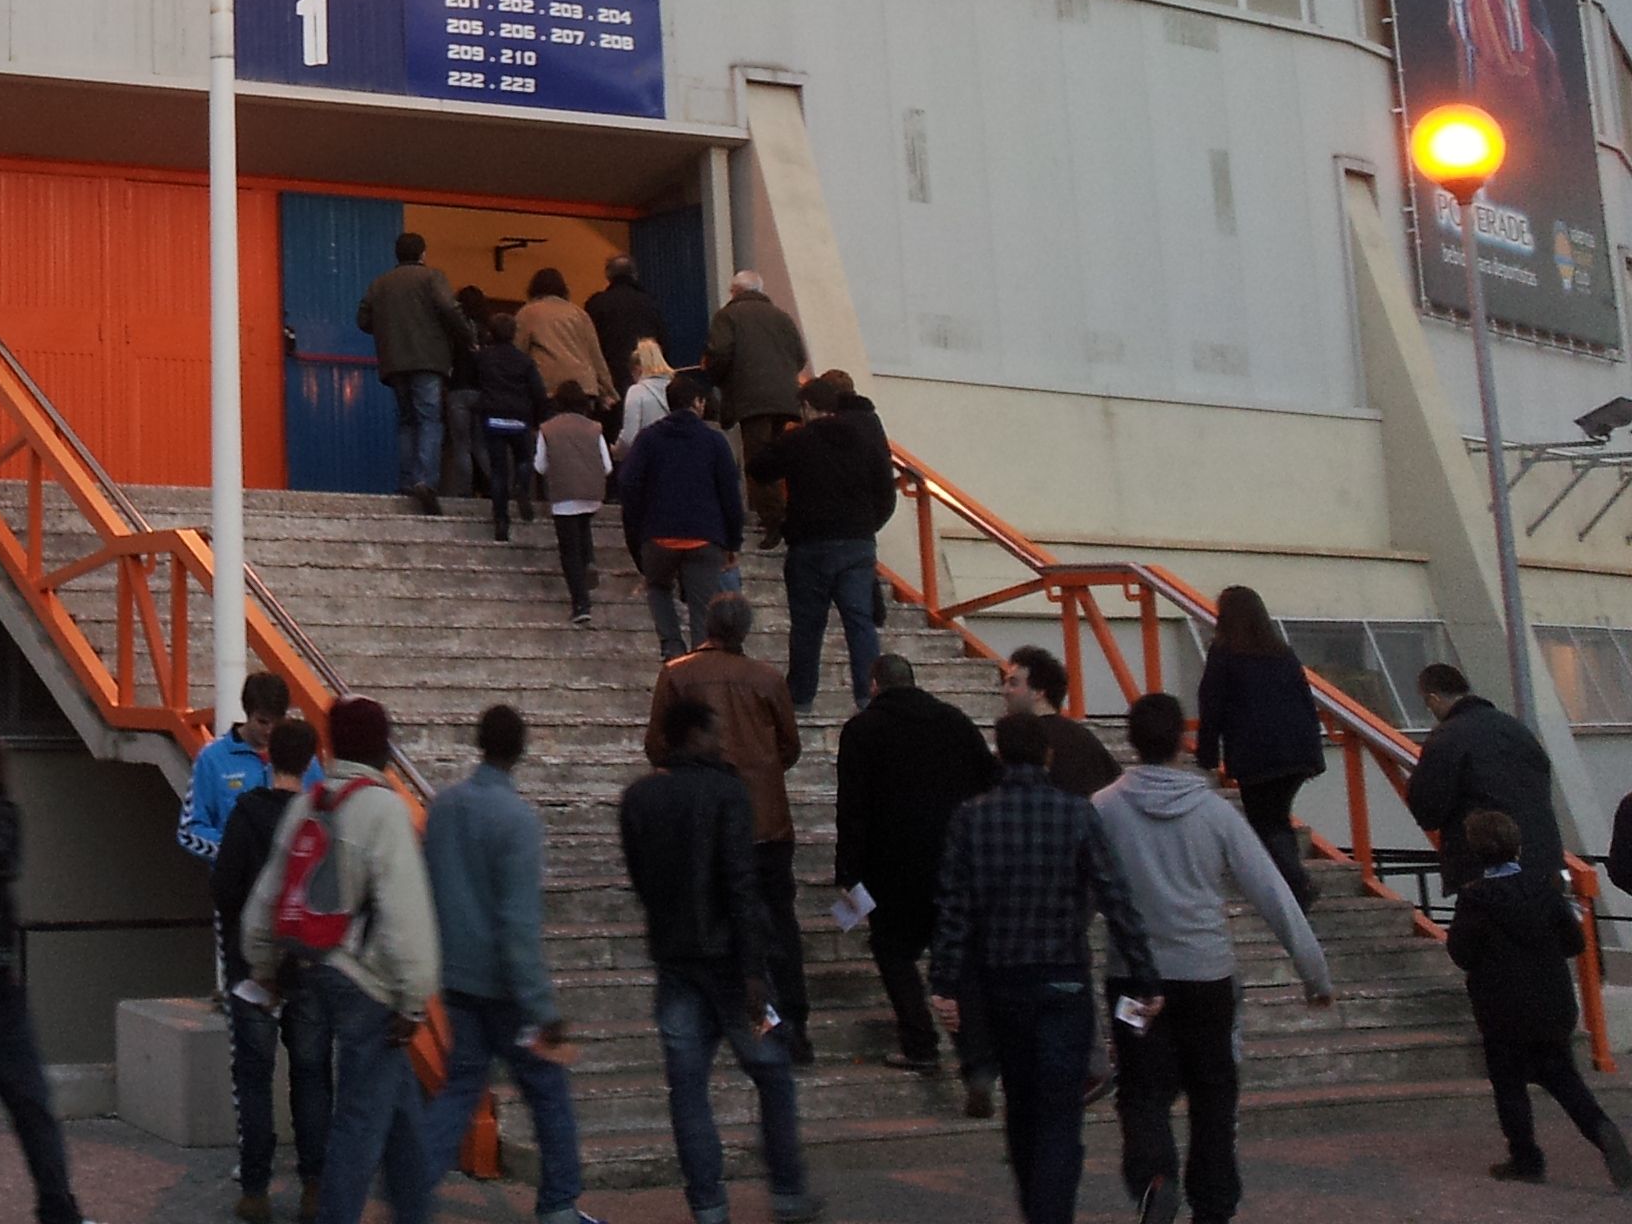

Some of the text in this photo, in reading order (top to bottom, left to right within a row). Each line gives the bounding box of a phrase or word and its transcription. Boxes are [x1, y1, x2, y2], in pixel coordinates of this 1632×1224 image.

[549, 2, 583, 19] 203
[598, 8, 632, 25] 204
[446, 19, 634, 51] 205 206 207 208
[447, 44, 536, 66] 209 210
[448, 71, 536, 93] 222 223
[1437, 192, 1534, 246] POERADE
